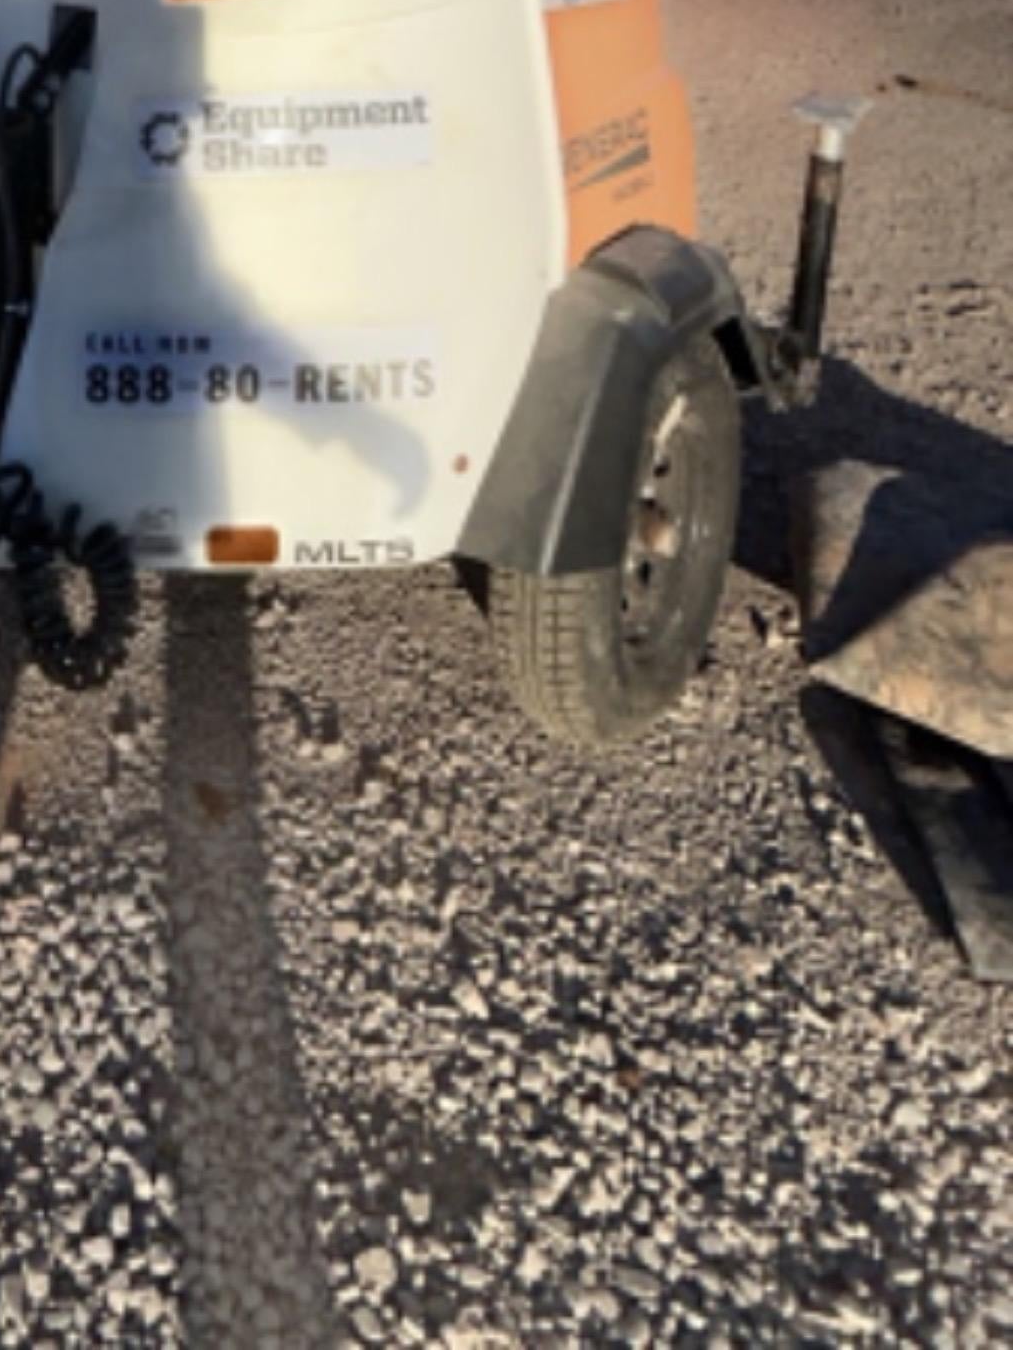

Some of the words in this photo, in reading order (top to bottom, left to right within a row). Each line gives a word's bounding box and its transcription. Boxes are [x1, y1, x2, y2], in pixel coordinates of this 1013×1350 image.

[201, 96, 429, 137] Equipment
[201, 139, 327, 171] Share
[85, 358, 436, 405] 888-80-RENTS
